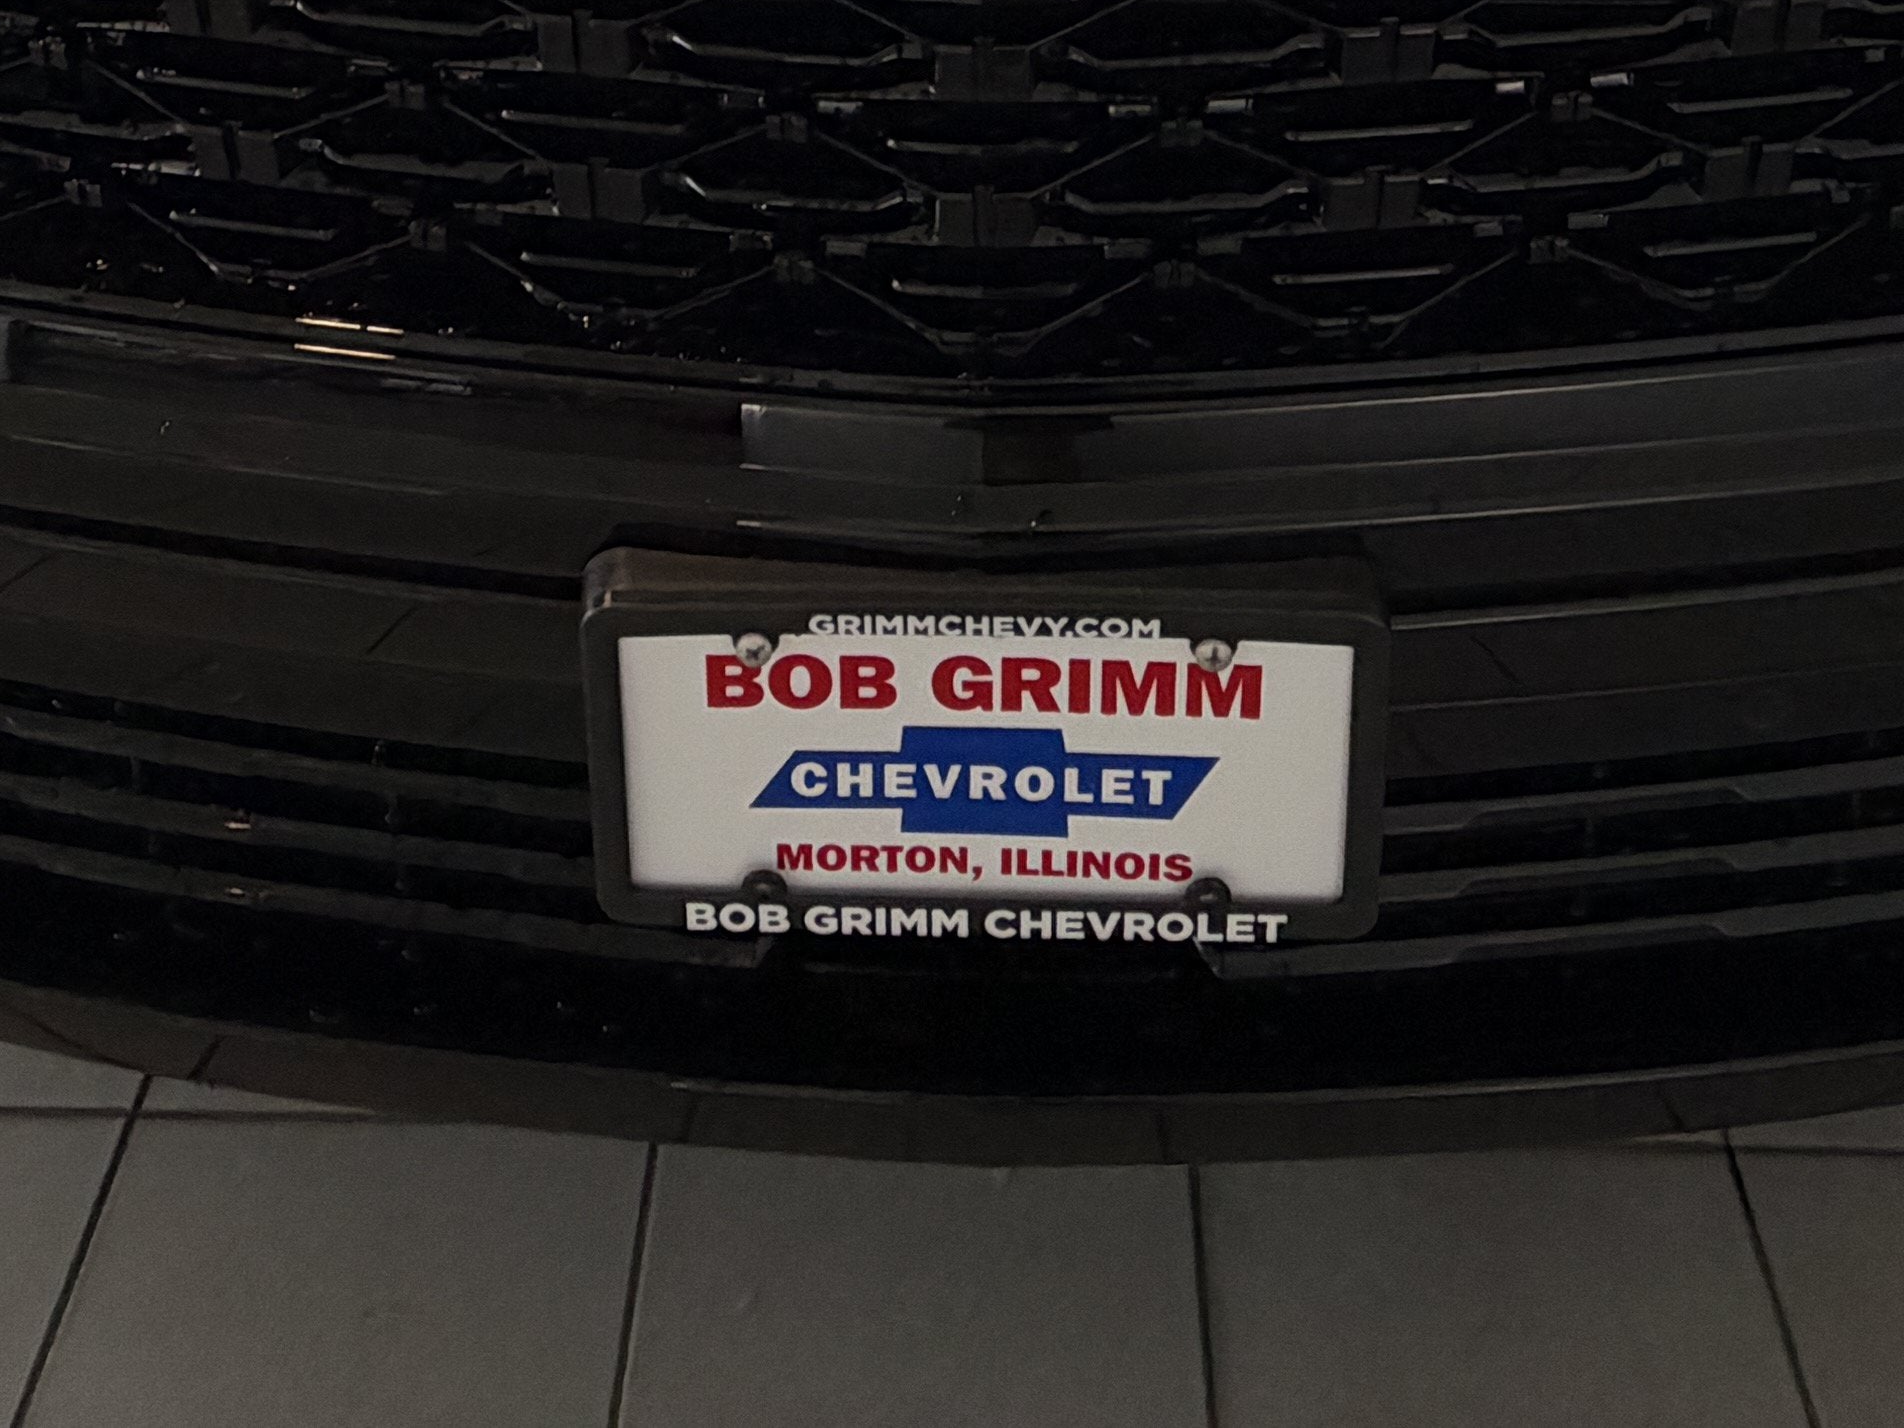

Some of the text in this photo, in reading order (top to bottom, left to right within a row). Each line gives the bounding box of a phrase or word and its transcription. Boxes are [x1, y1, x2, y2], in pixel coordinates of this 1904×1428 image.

[808, 615, 1161, 639] GRIMMCHEVY.COM
[705, 653, 1263, 720] BOB GRIMM
[790, 762, 1173, 805] CHEVROLET
[776, 843, 1194, 882] MORTON, ILLINOIS
[685, 902, 1288, 943] BOB GRIMM CHEVROLET
